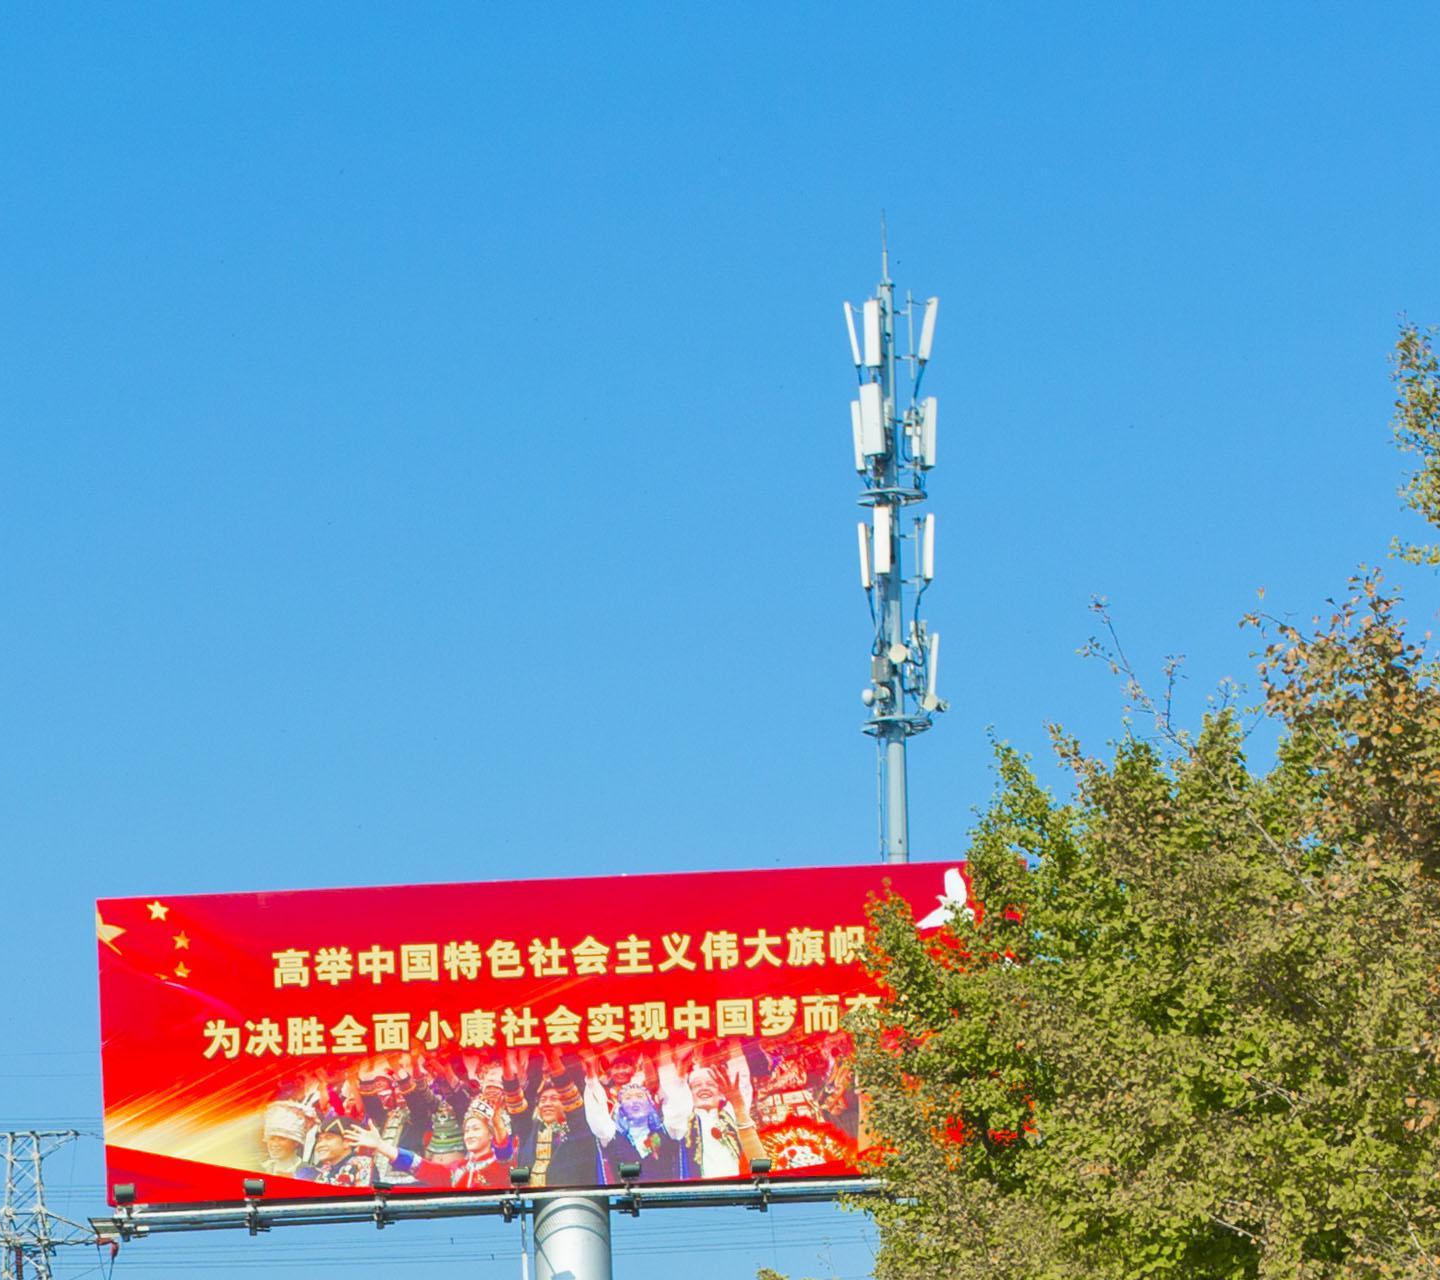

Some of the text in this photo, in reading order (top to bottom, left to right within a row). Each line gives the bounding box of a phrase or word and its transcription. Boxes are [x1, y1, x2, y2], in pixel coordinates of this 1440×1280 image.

[272, 926, 867, 989] 高举中国特色社会主义伟大旗帜
